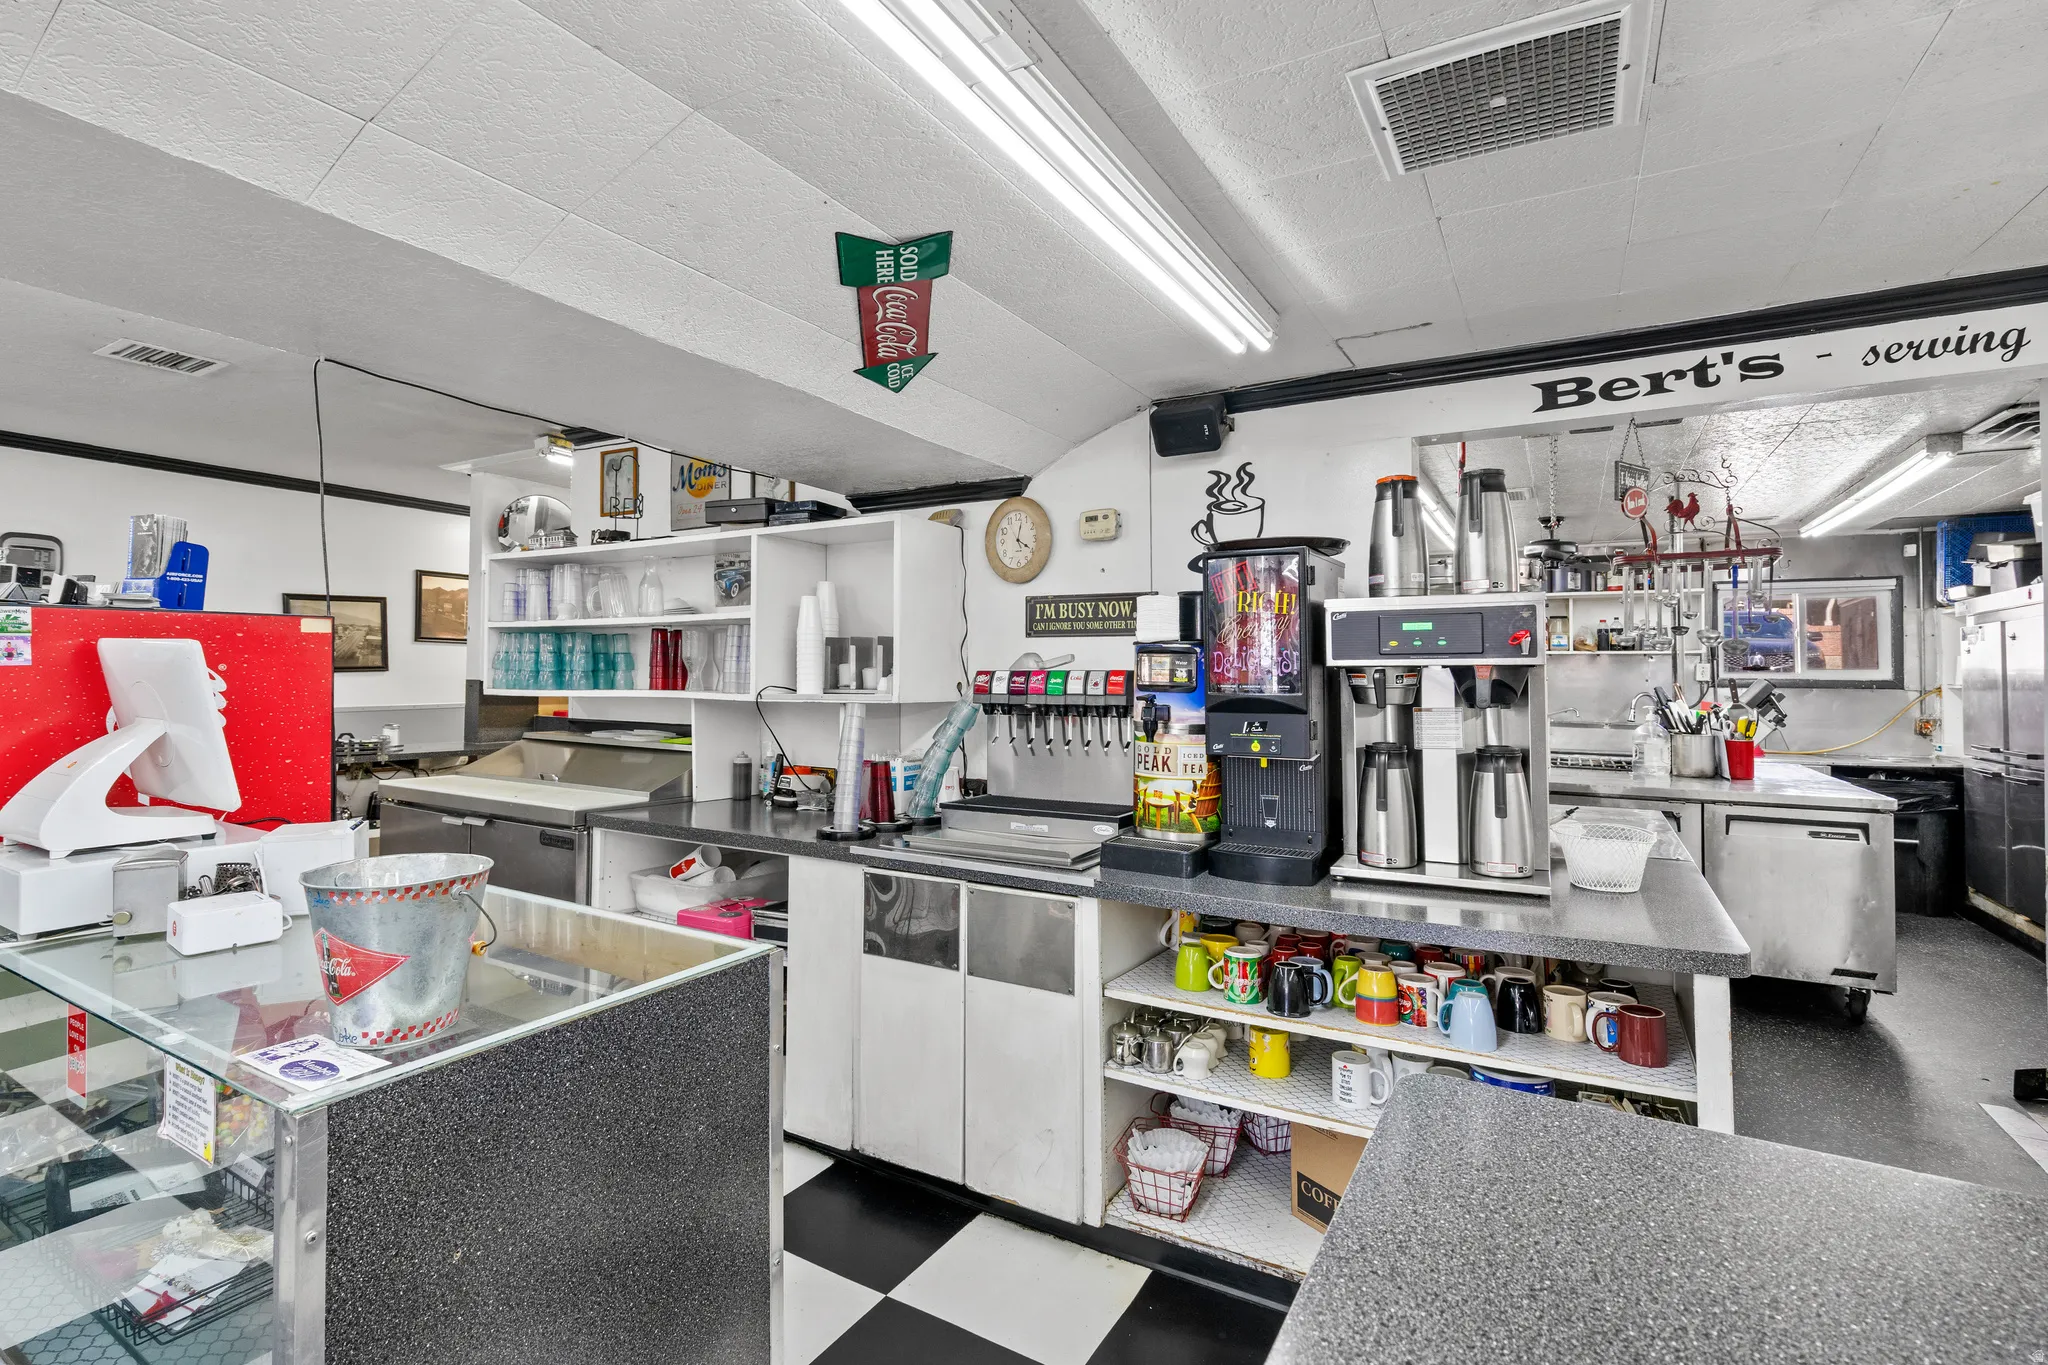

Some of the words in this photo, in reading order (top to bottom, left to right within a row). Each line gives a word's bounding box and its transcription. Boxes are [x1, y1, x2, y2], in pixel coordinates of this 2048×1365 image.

[875, 249, 894, 284] HERE
[900, 246, 918, 282] SOLD
[901, 363, 914, 379] ICE
[1530, 351, 1785, 413] Bert's
[1861, 324, 2032, 367] serving
[886, 362, 901, 389] COLD
[698, 481, 727, 491] DINER
[1007, 517, 1013, 526] 11
[1014, 512, 1022, 522] 12
[1024, 515, 1028, 524] 1
[1000, 527, 1008, 536] 10
[1030, 522, 1035, 531] 2
[1000, 538, 1005, 546] 9
[1032, 535, 1037, 543] 3
[1002, 549, 1008, 557] 8
[1008, 557, 1014, 566] 7
[1016, 559, 1022, 568] 6
[1024, 556, 1029, 564] 5
[1237, 590, 1297, 615] RICH!
[1035, 603, 1056, 619] I'M
[1059, 602, 1096, 619] BUSY
[1033, 622, 1045, 631] CAN
[1049, 622, 1072, 630] IGNORE
[1073, 621, 1086, 630] YOU
[1086, 621, 1103, 629] SOME
[1104, 620, 1126, 629] OTHER
[1216, 613, 1290, 645] Creay
[1137, 743, 1172, 755] GOLD
[1137, 753, 1172, 773] PEAK
[1183, 763, 1204, 774] TEA
